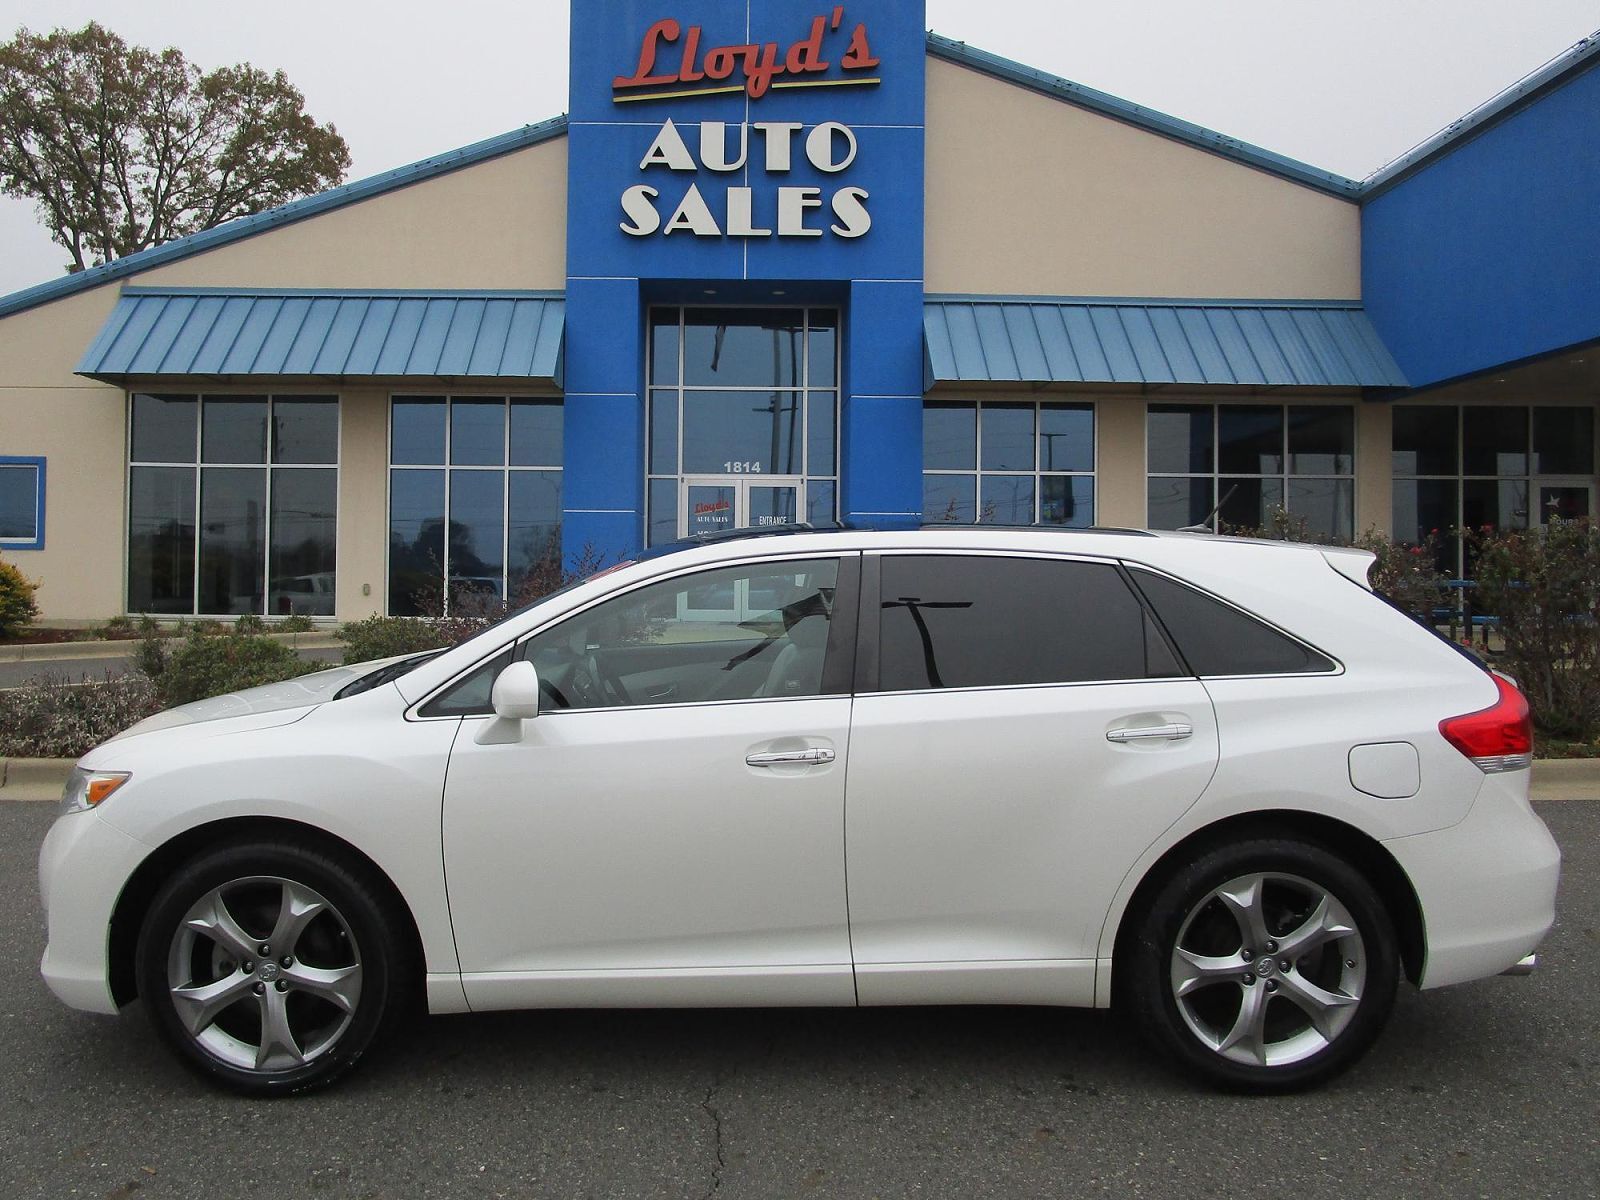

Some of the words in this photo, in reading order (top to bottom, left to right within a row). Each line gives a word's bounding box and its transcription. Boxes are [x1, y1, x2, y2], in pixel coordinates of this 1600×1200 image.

[612, 6, 880, 98] Lloyd's
[639, 117, 857, 172] AUTO
[619, 182, 871, 238] SALES
[724, 461, 761, 473] 1814
[759, 516, 787, 525] ENTRANCE
